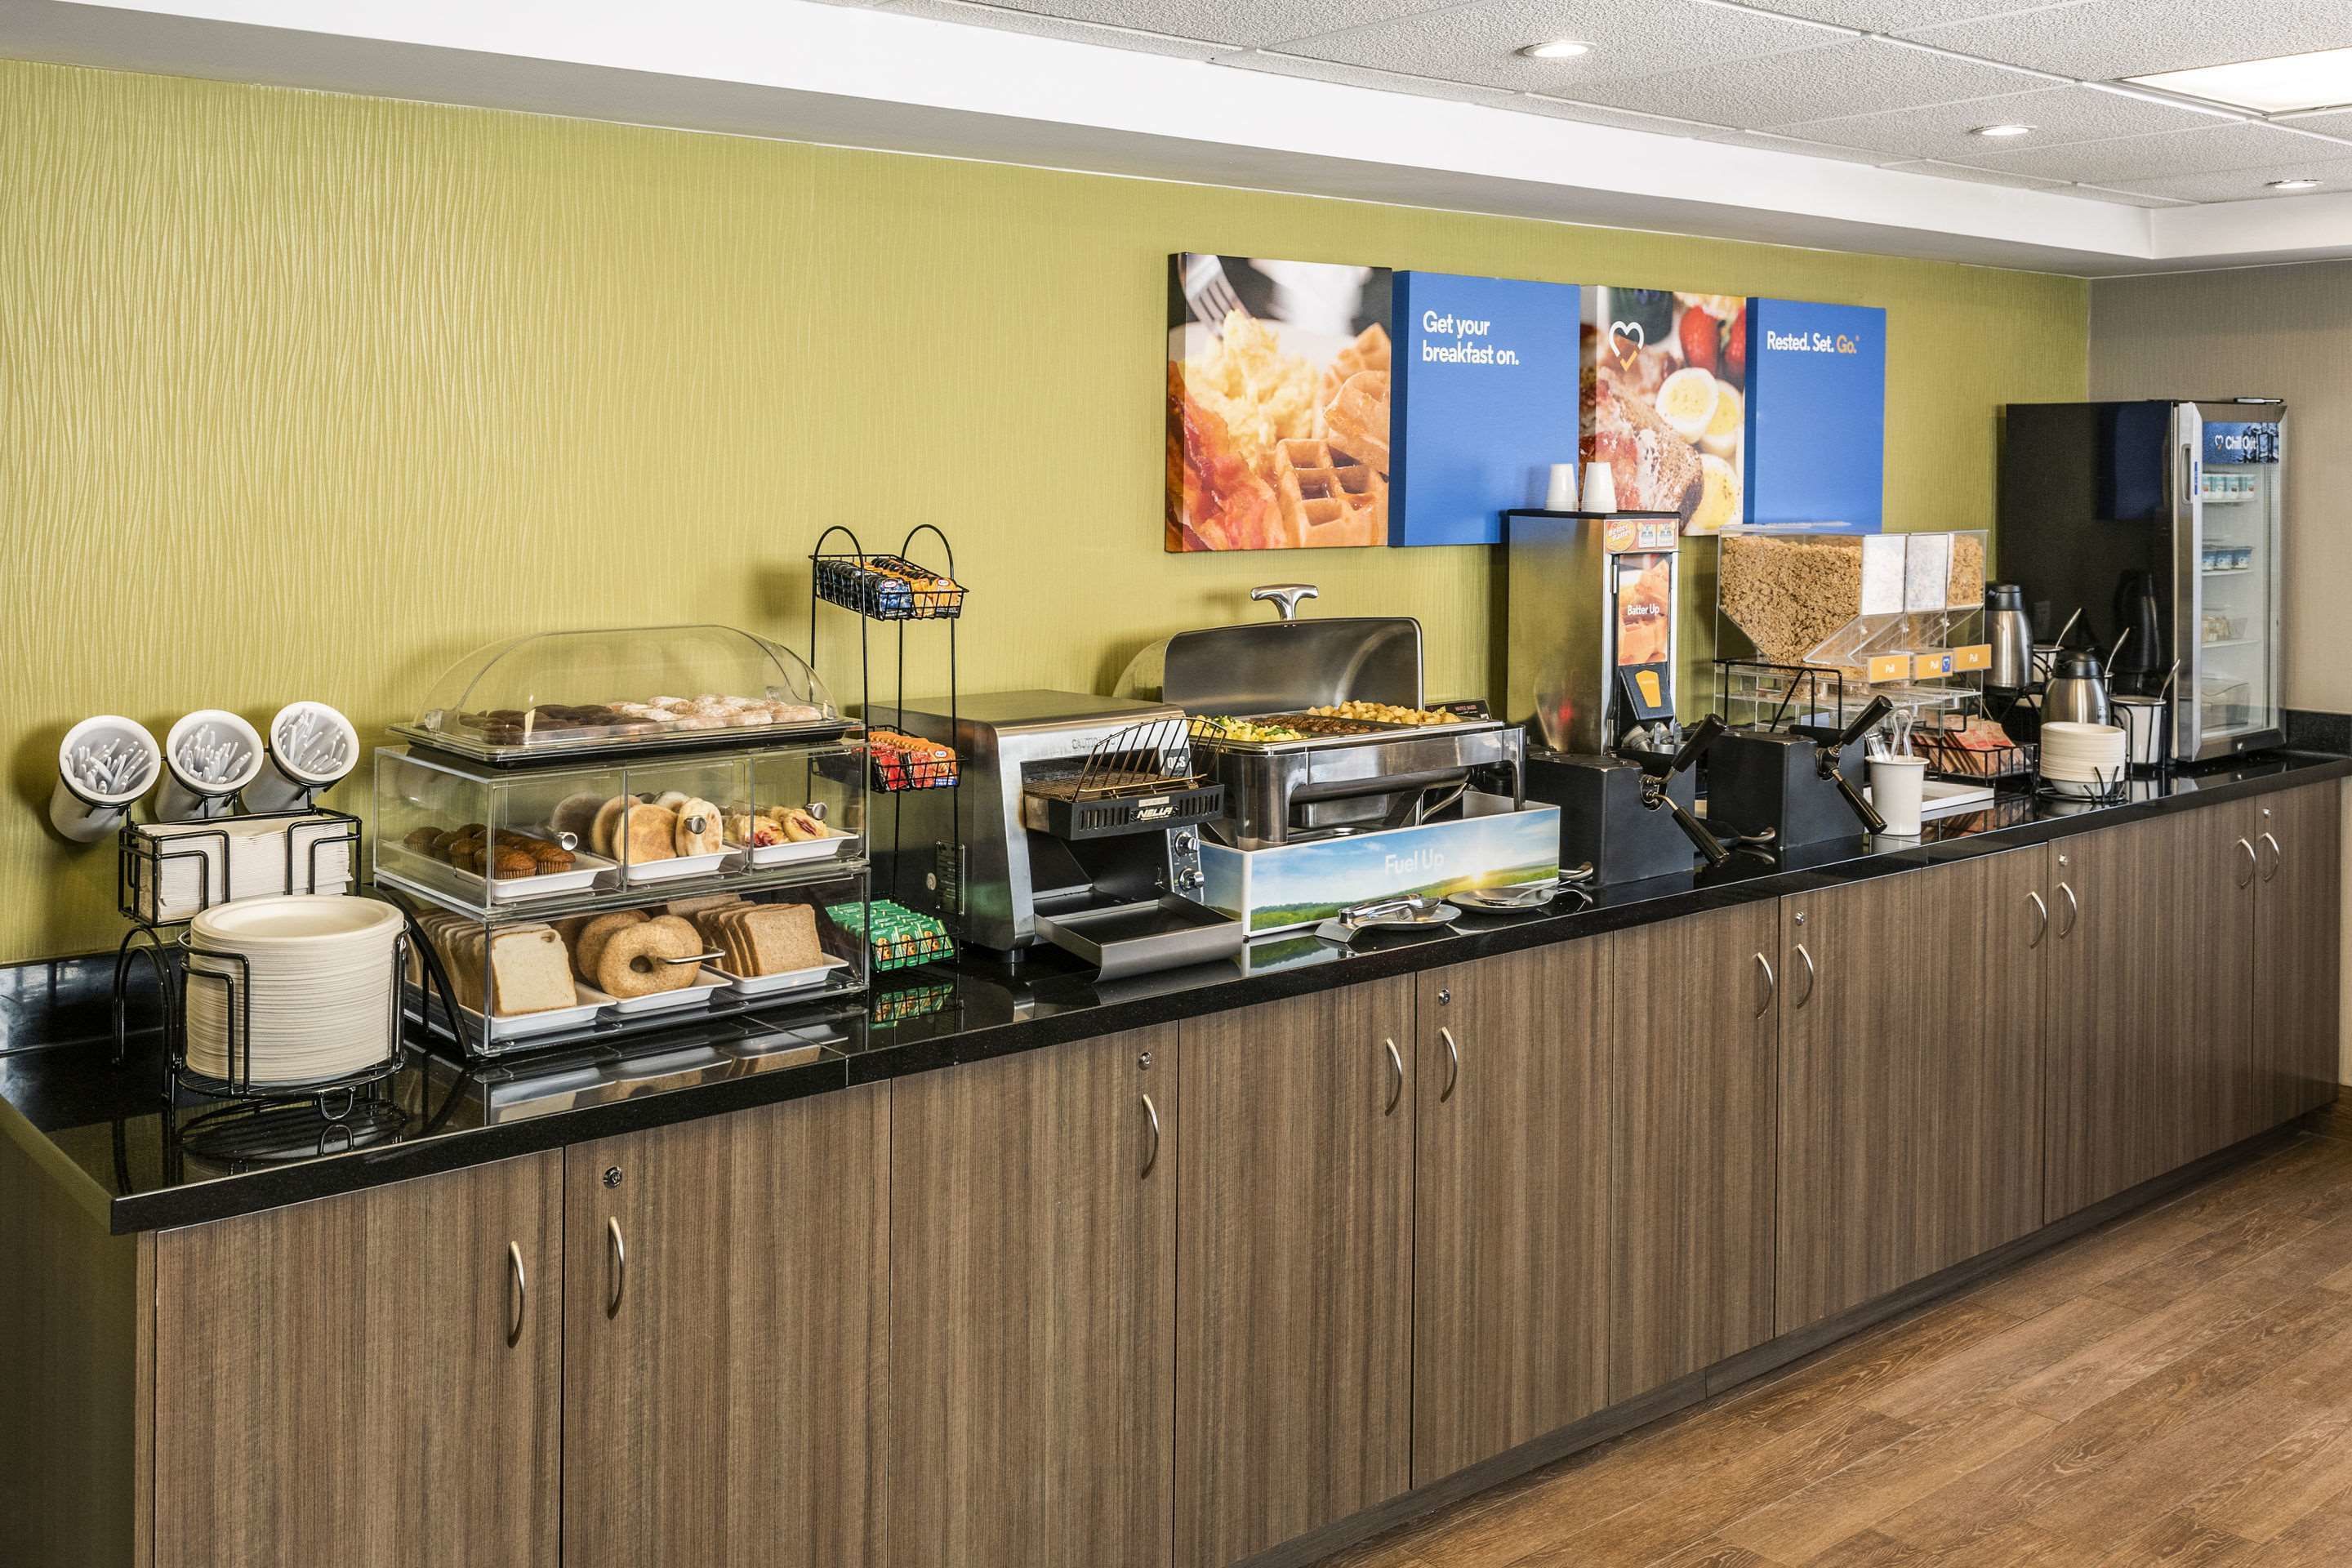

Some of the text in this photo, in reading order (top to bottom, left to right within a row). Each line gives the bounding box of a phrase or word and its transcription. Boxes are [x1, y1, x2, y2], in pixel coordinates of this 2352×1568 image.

[1423, 310, 1490, 339] Get your
[1766, 330, 1811, 351] Rested.
[1812, 332, 1834, 353] Set.
[1423, 340, 1520, 365] breakfast on.
[2225, 435, 2257, 450] Chill Out
[1627, 604, 1660, 617] Batter Up
[1930, 660, 1940, 670] Pull
[1969, 653, 1979, 663] Pull
[1885, 664, 1895, 674] Pull
[1136, 805, 1174, 819] NELLA
[1385, 849, 1445, 876] Fuel Up
